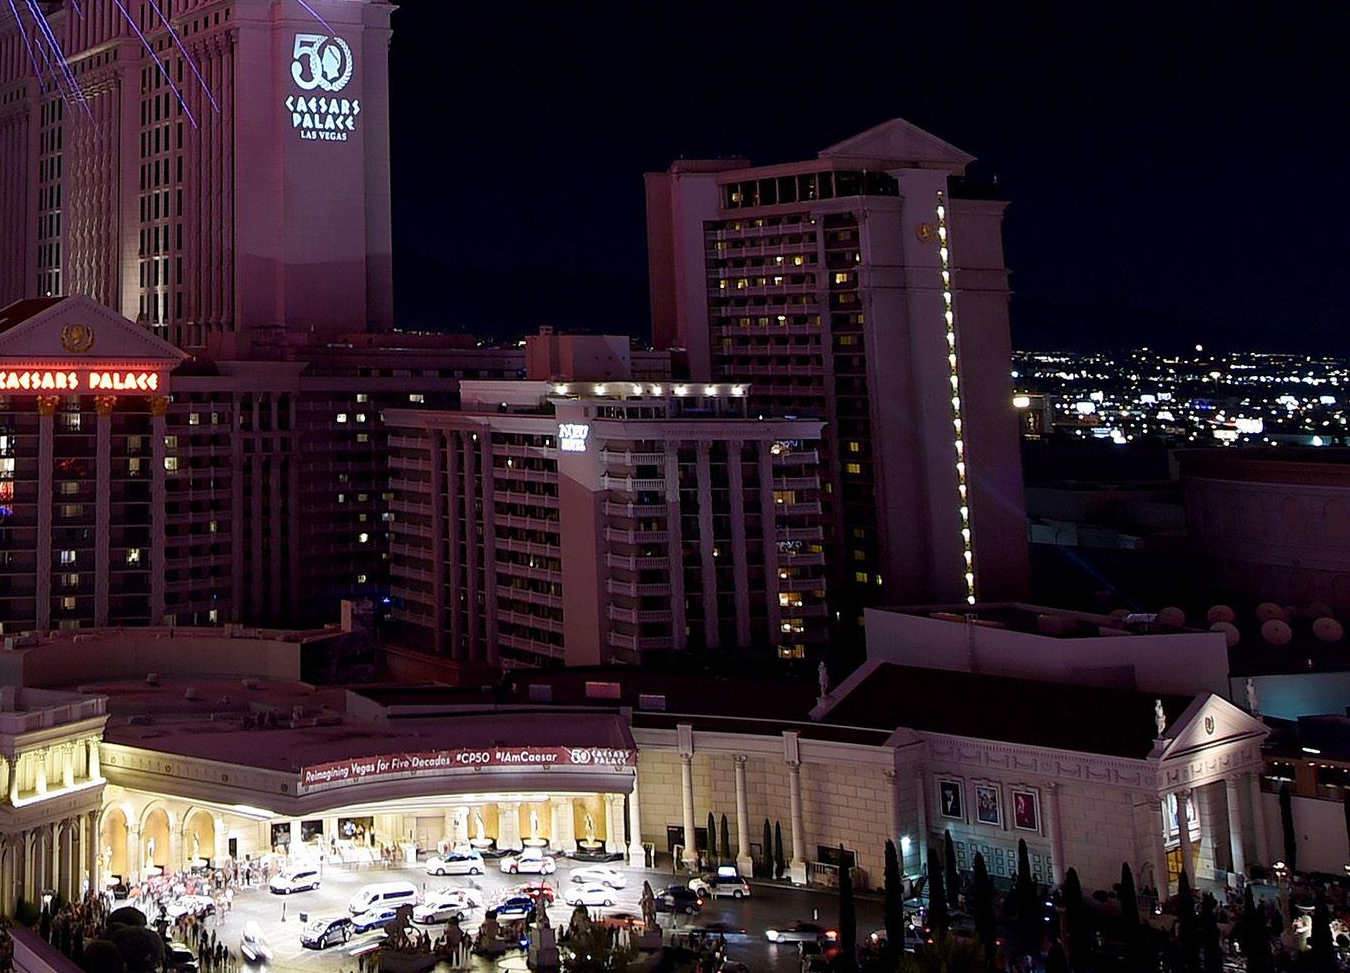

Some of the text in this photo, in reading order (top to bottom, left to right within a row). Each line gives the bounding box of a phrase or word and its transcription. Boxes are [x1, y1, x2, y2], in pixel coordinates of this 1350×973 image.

[285, 95, 361, 116] CAESARS
[293, 112, 355, 130] PALACE
[301, 130, 347, 141] LAS VEGAS
[89, 372, 158, 391] PALACE
[305, 751, 557, 783] Reimagining Vegas for Five Decades #CP50 #IAmCaesar
